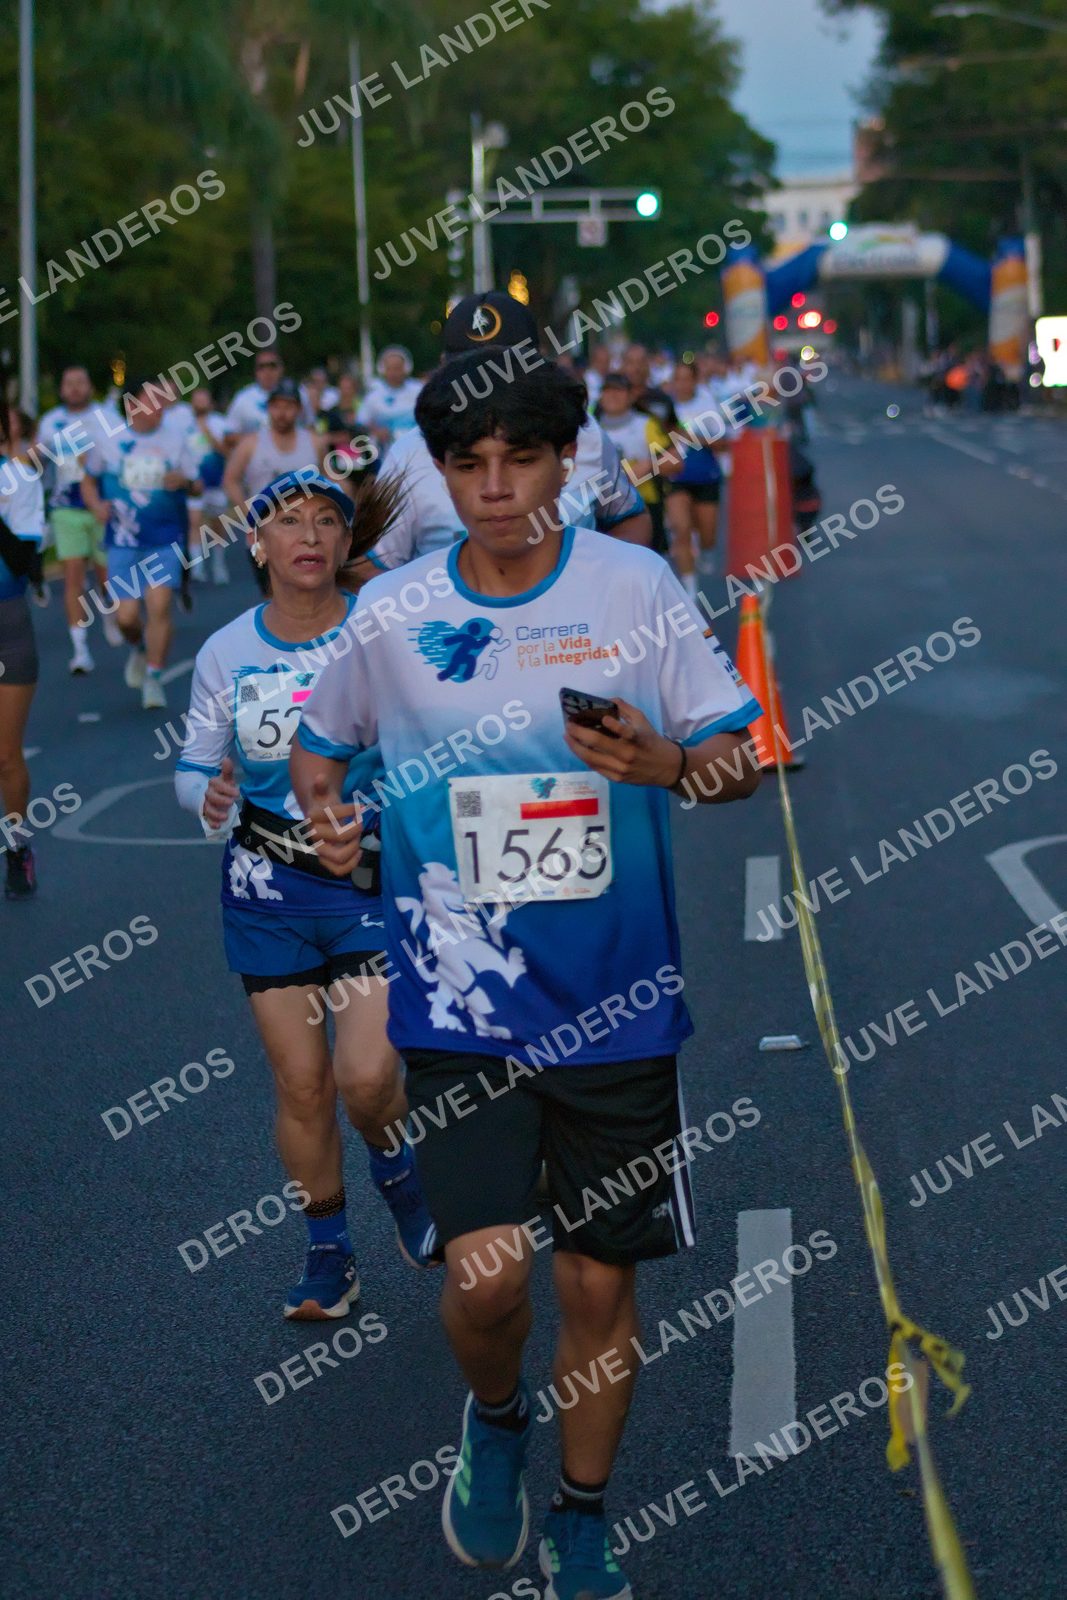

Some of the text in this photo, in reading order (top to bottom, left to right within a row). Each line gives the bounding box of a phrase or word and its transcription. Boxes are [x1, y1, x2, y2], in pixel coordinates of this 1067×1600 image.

[516, 623, 589, 640] Carrera
[517, 636, 591, 656] por la Vida
[517, 644, 619, 671] y la Integridad
[465, 825, 607, 884] 1565
